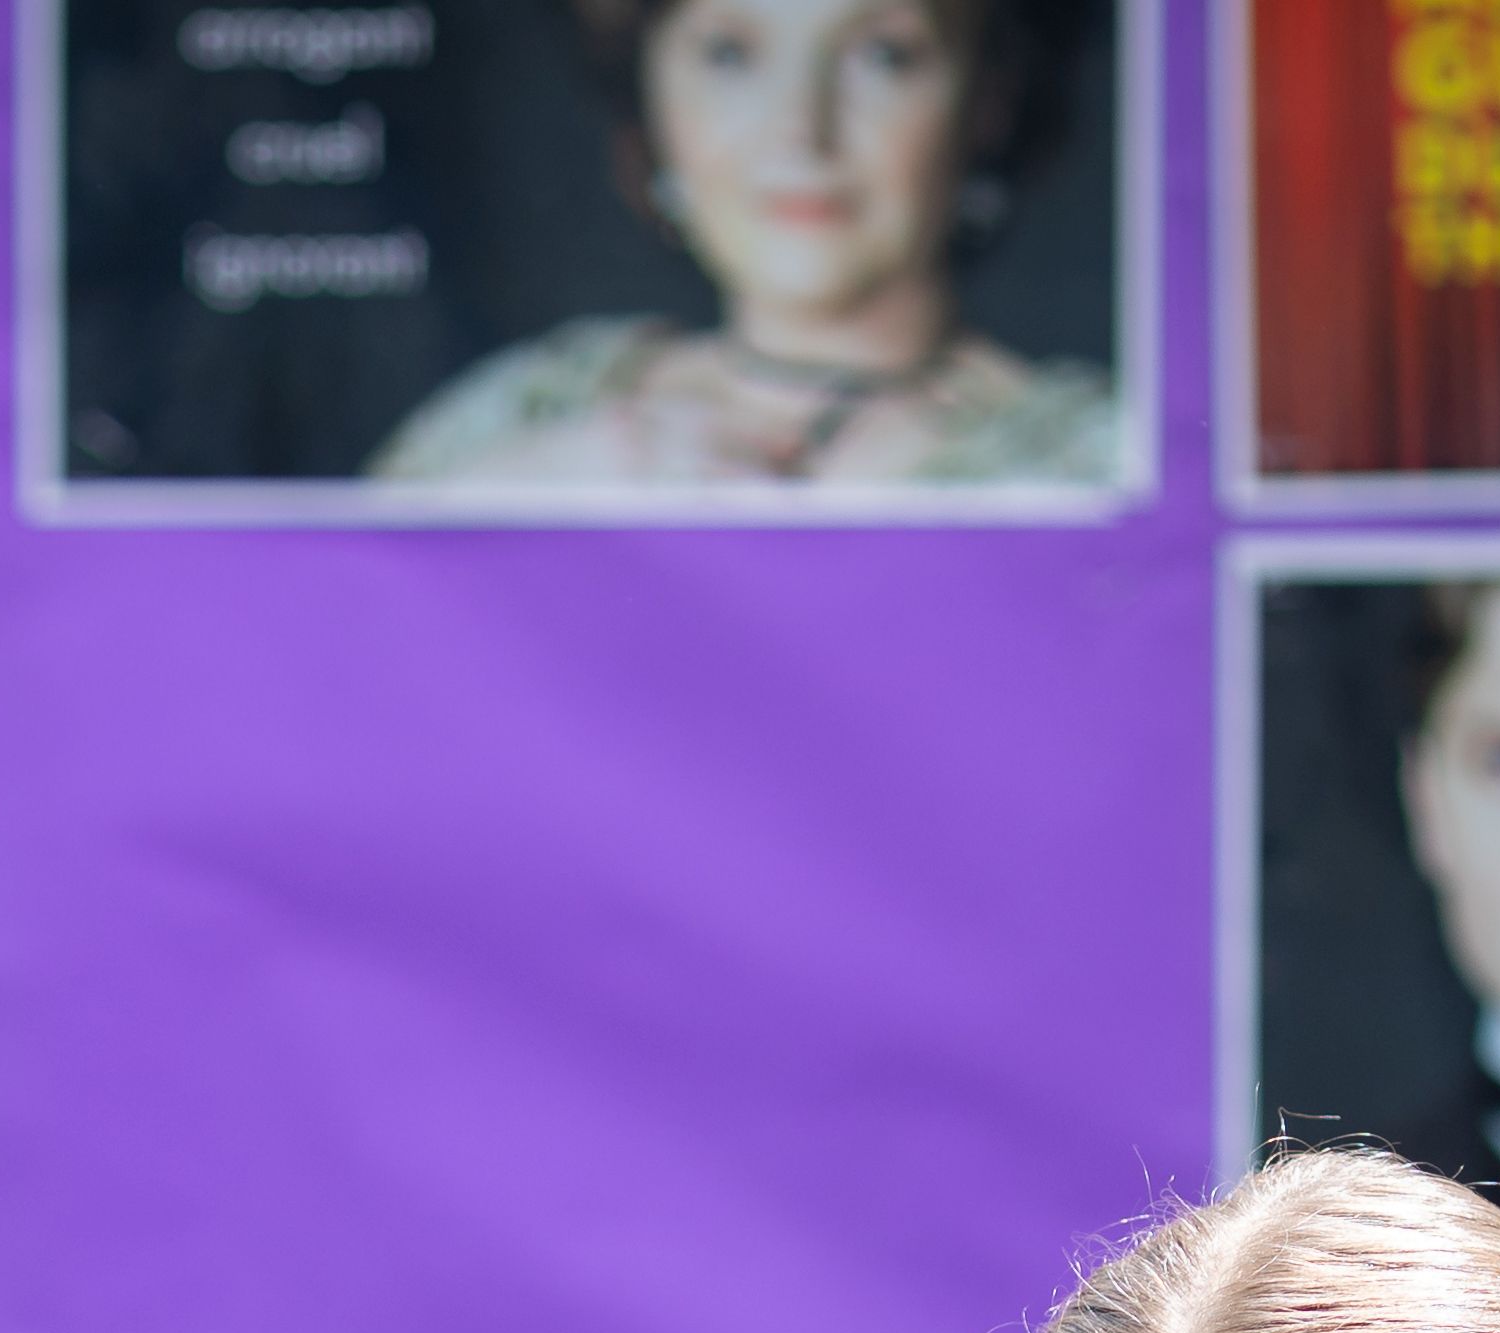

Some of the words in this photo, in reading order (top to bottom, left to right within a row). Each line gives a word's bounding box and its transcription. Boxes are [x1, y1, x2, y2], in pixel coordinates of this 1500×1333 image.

[178, 5, 434, 83] arrogant
[226, 102, 385, 184] cruel
[183, 221, 428, 312] ignorant
